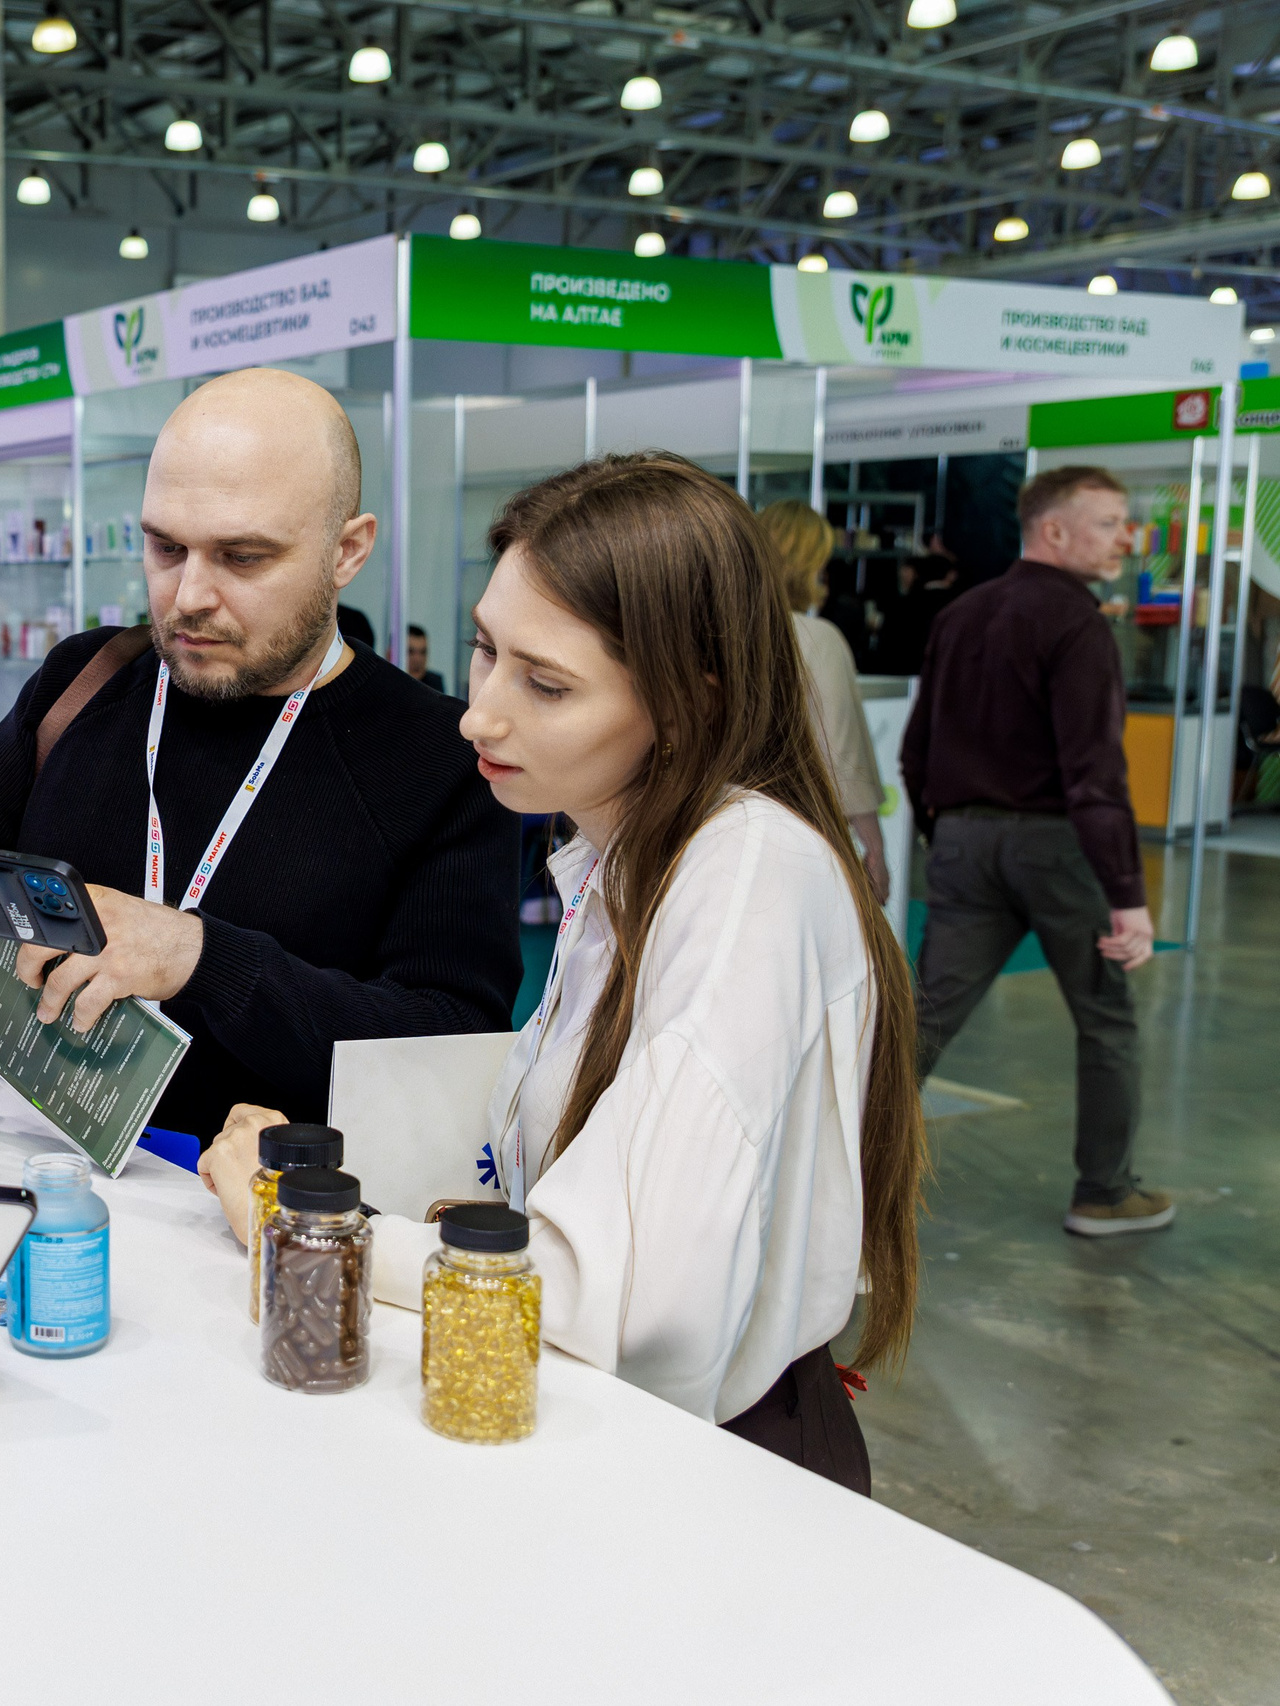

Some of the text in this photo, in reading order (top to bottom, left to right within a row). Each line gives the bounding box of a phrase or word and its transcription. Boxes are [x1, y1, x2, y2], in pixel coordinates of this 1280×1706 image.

[190, 278, 332, 325] ПРОИЗВОДСТВО БАД
[530, 272, 670, 302] ПРОИЗВЕДЕНО
[530, 303, 624, 327] НА АЛТАЕ
[1001, 309, 1114, 331] ПРОИЗВОДСТВО
[202, 314, 311, 349] КОСМЕЦЕВТИКИ
[1015, 336, 1128, 356] КОСМЕЦЕВТИКИ
[208, 831, 228, 863] МАГНИТ
